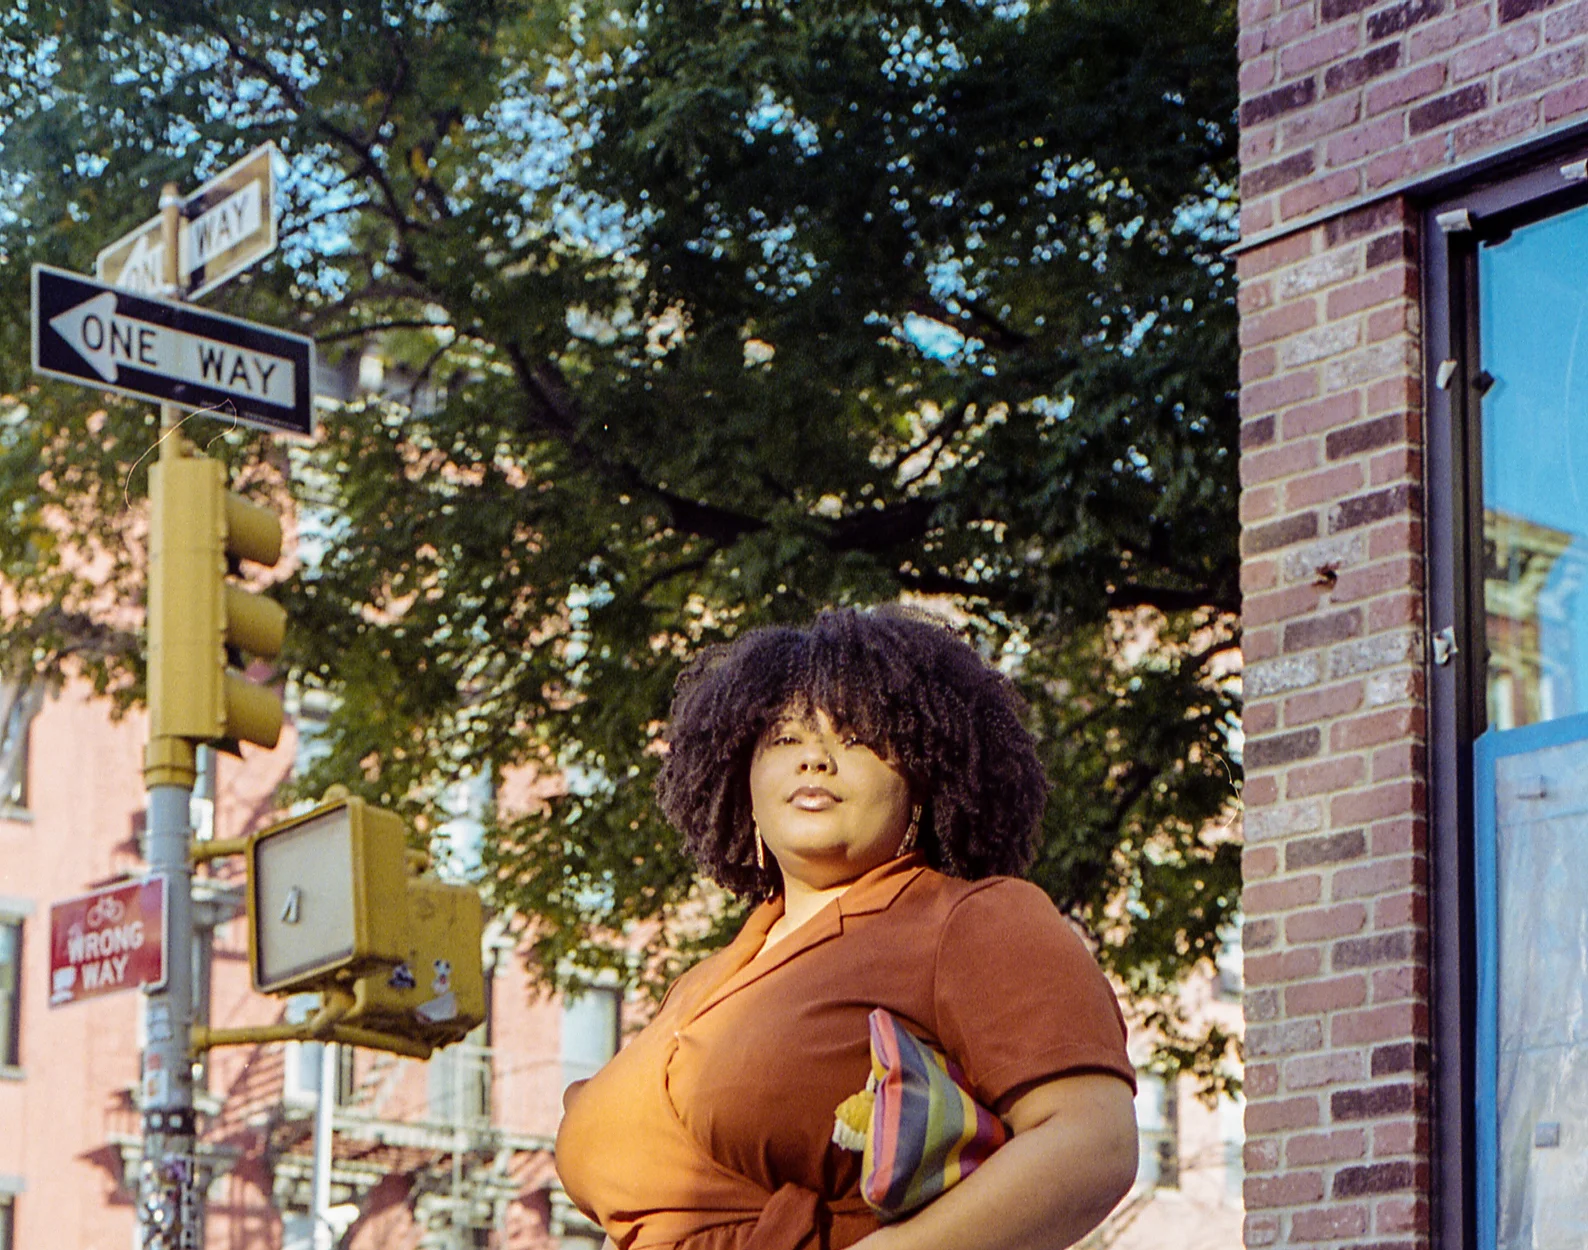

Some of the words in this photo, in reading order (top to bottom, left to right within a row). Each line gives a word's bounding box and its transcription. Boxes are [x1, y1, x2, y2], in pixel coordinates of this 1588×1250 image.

[196, 193, 248, 257] WAY
[82, 315, 157, 367] ONE
[199, 345, 277, 396] WAY
[67, 921, 144, 965] WRONG
[82, 954, 129, 990] WAY
